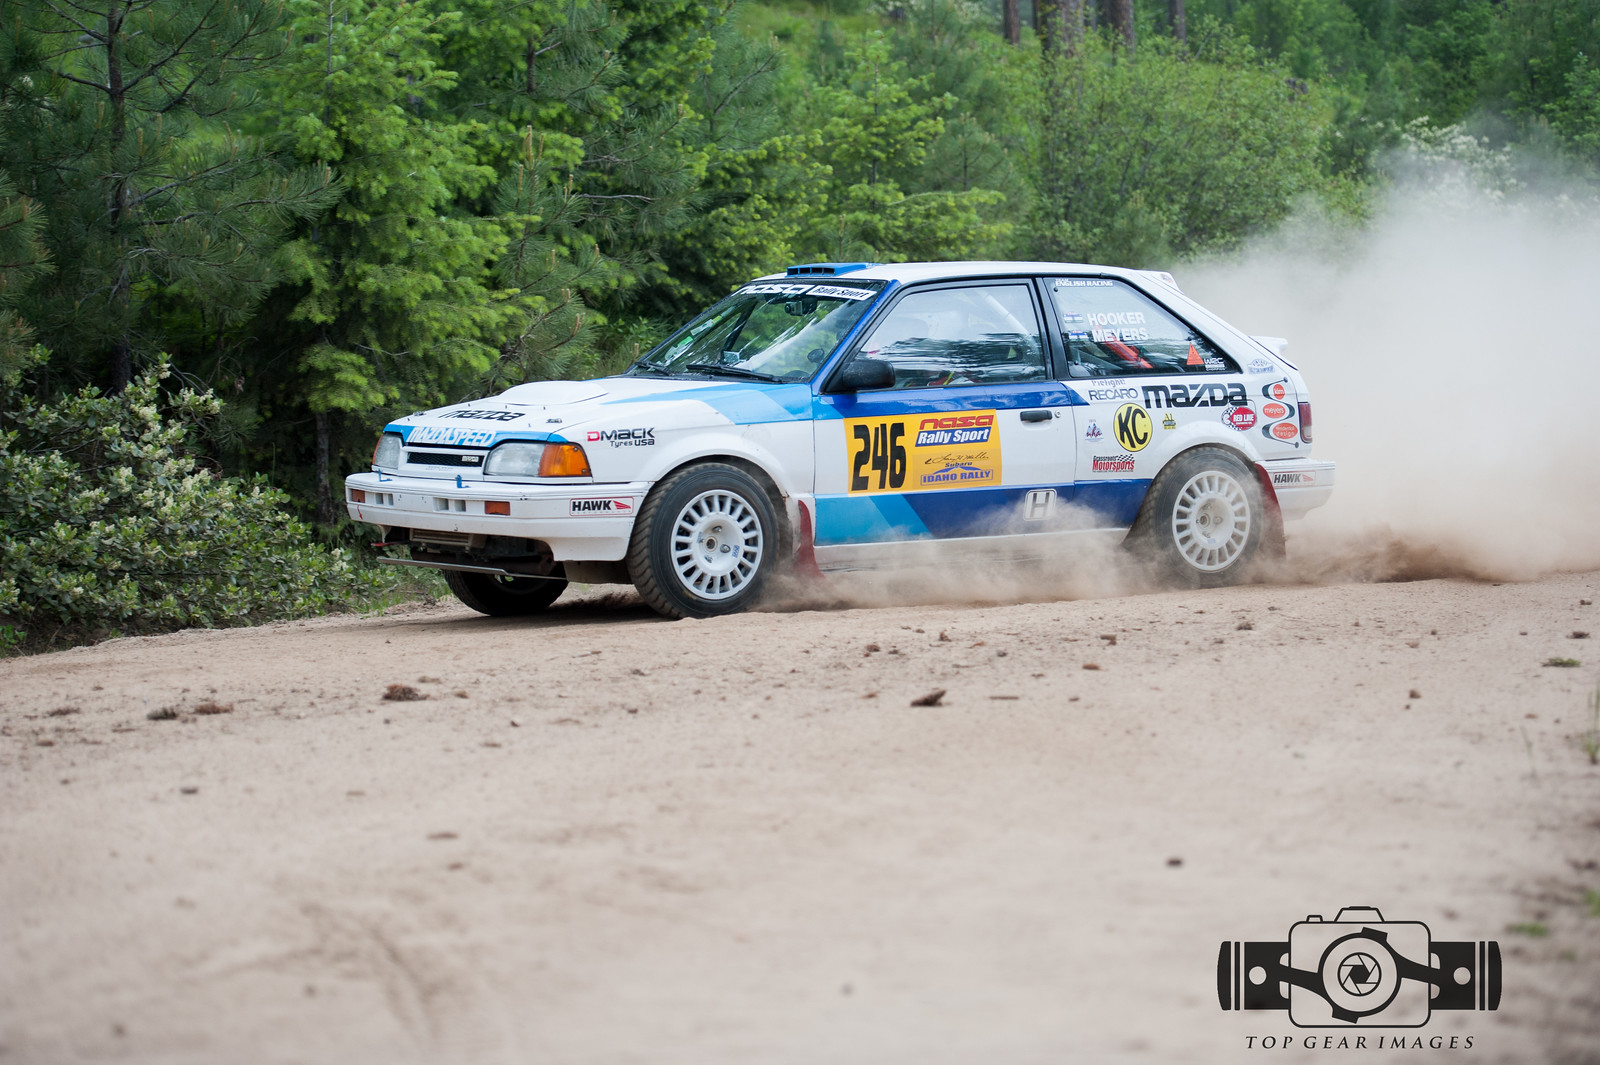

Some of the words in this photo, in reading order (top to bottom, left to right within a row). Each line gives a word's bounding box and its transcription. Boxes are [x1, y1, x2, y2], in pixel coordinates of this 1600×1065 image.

[814, 286, 838, 296] Rally
[837, 288, 870, 299] Sport
[1086, 311, 1146, 326] HOOKER
[1091, 327, 1150, 342] MEYERS
[1088, 388, 1138, 401] RECARO
[1264, 406, 1285, 415] meyers
[1118, 406, 1149, 449] KC
[406, 426, 498, 447] MAZDASPEED
[917, 430, 952, 445] Rally
[952, 428, 990, 443] Sport
[610, 440, 633, 448] Tyres
[851, 422, 907, 492] 246
[1092, 459, 1135, 473] Motorsports
[923, 473, 957, 483] IDAHO
[960, 470, 991, 480] RALLY
[1273, 473, 1301, 483] HAWK
[571, 500, 612, 511] HAWK
